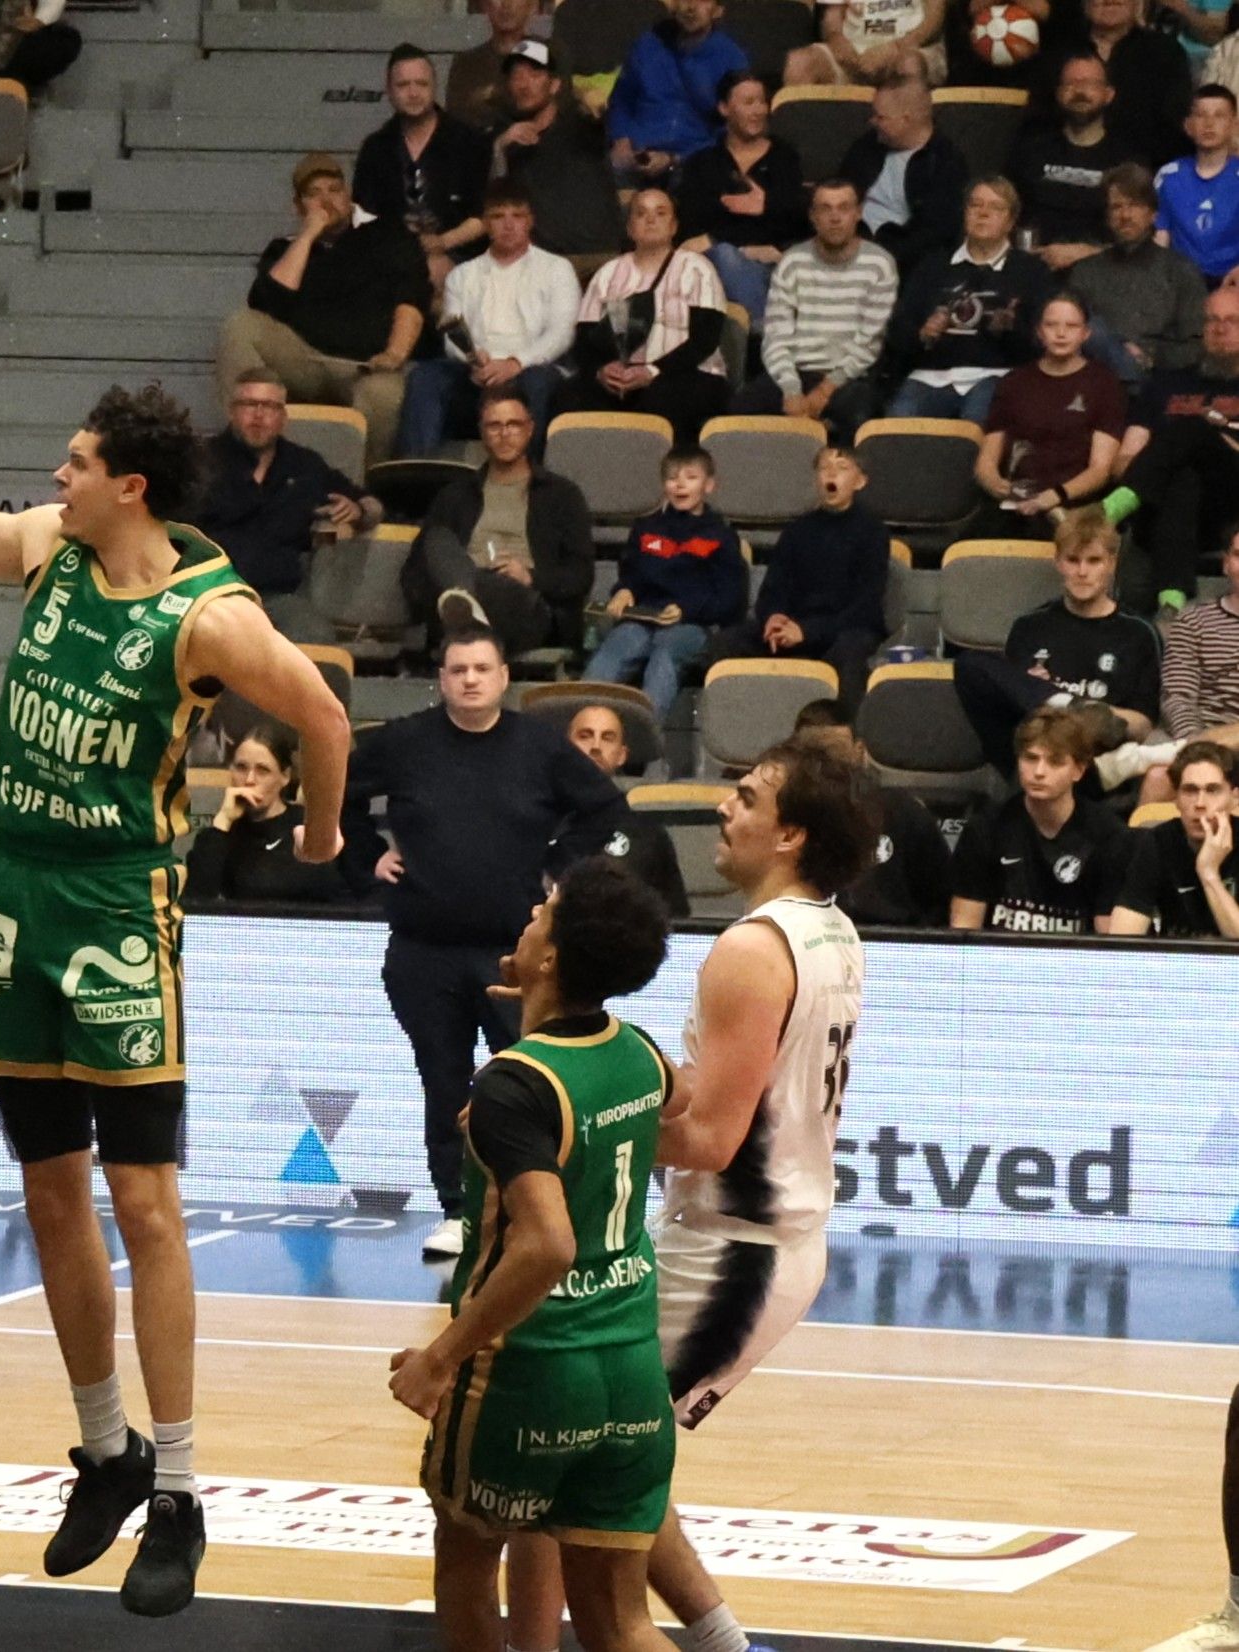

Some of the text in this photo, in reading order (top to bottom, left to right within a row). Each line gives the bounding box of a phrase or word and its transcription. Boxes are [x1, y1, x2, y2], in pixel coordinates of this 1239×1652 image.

[33, 585, 72, 645] 5
[26, 669, 119, 717] GOURMET
[95, 670, 143, 700] Albani
[9, 679, 138, 769] VOGNEN
[12, 781, 123, 829] SJF BANK
[78, 1003, 144, 1020] DAVIDSEN
[596, 1089, 661, 1129] KIROPRAKTIS
[833, 1125, 1132, 1216] stved
[604, 1140, 634, 1252] 1
